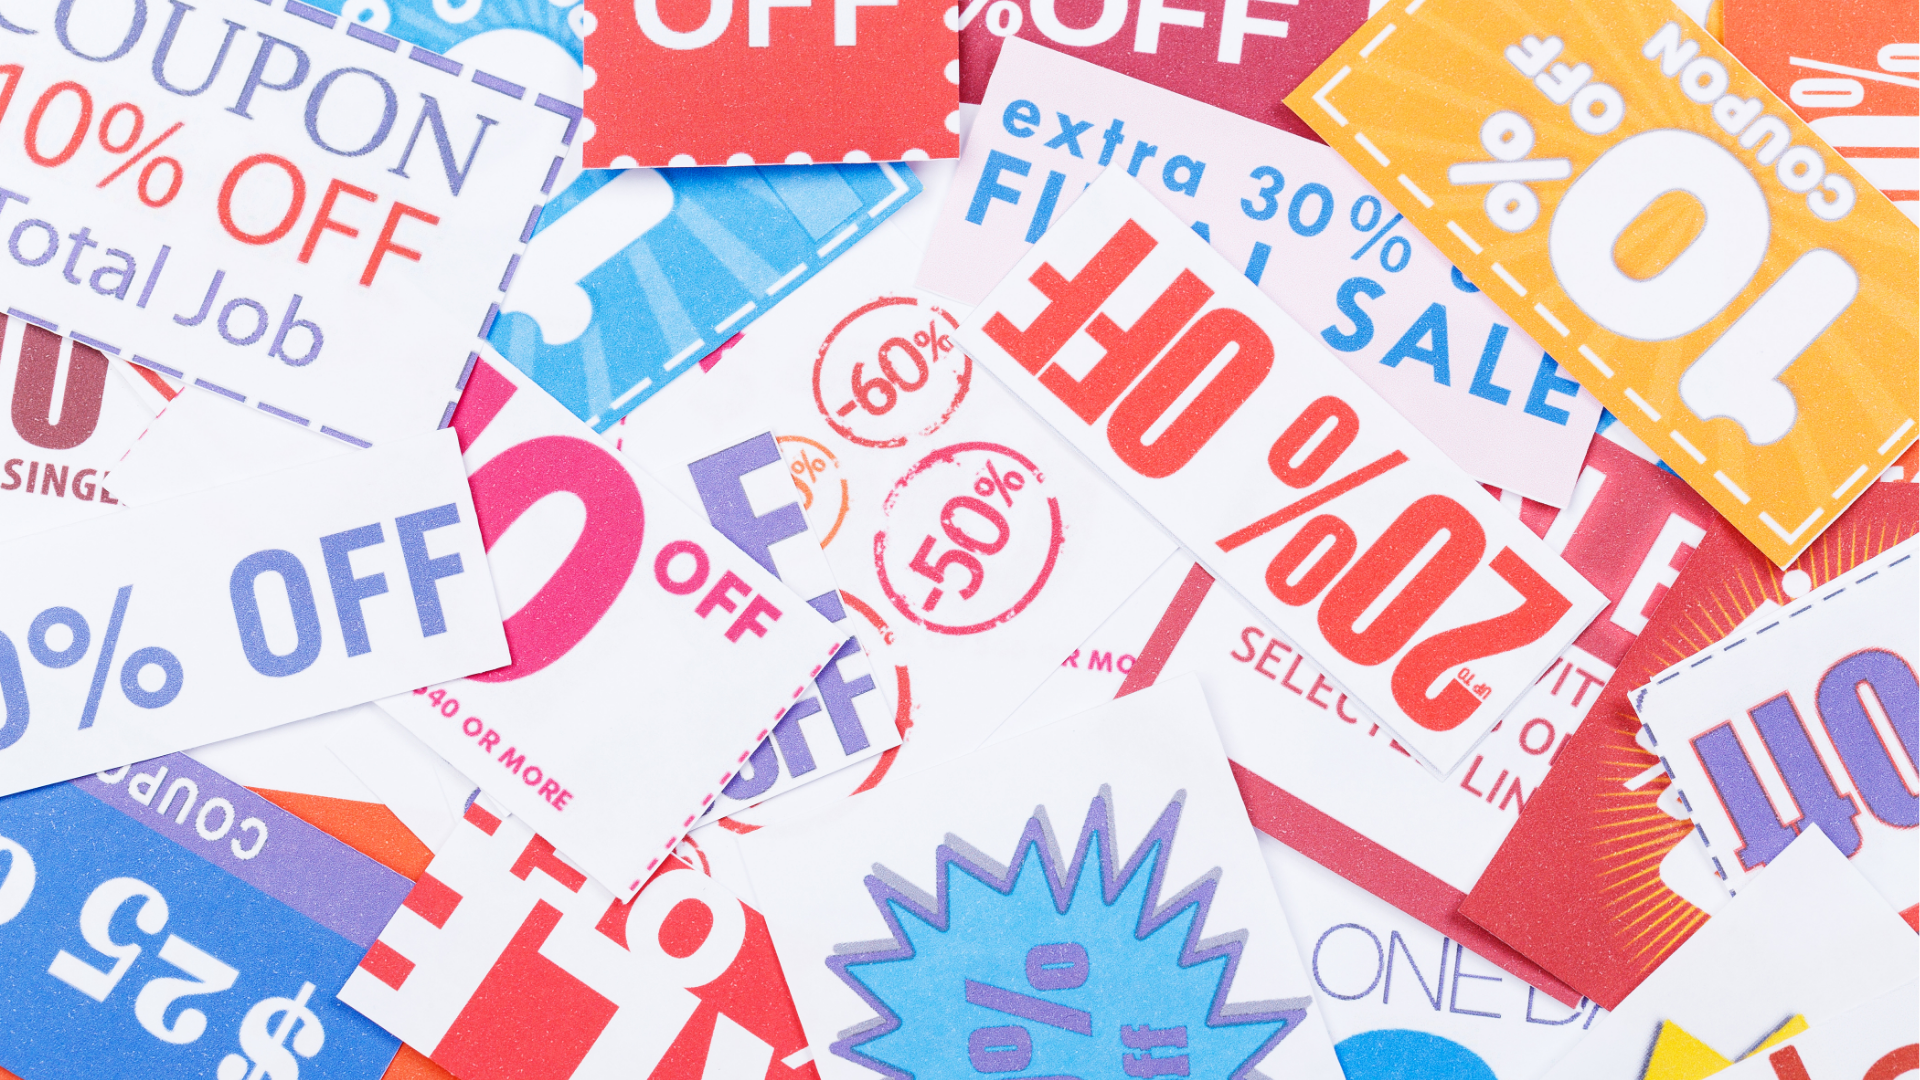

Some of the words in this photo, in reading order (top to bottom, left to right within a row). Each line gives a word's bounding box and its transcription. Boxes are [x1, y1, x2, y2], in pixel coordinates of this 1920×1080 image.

[0, 0, 499, 197] OUPON
[1504, 35, 1626, 136] OFF
[1643, 20, 1856, 222] COUPON
[217, 153, 440, 287] OFF
[1002, 100, 1208, 198] extra
[1240, 165, 1412, 273] 30%
[173, 268, 324, 367] Job
[981, 218, 1275, 479] OFF
[1320, 277, 1580, 426] SALE
[230, 502, 464, 678] OFF
[653, 540, 783, 644] OFF
[909, 459, 1025, 612] -50%
[1217, 395, 1573, 733] 20%
[462, 716, 501, 753] OR
[497, 746, 574, 812] MORE
[1312, 922, 1502, 1018] ONE
